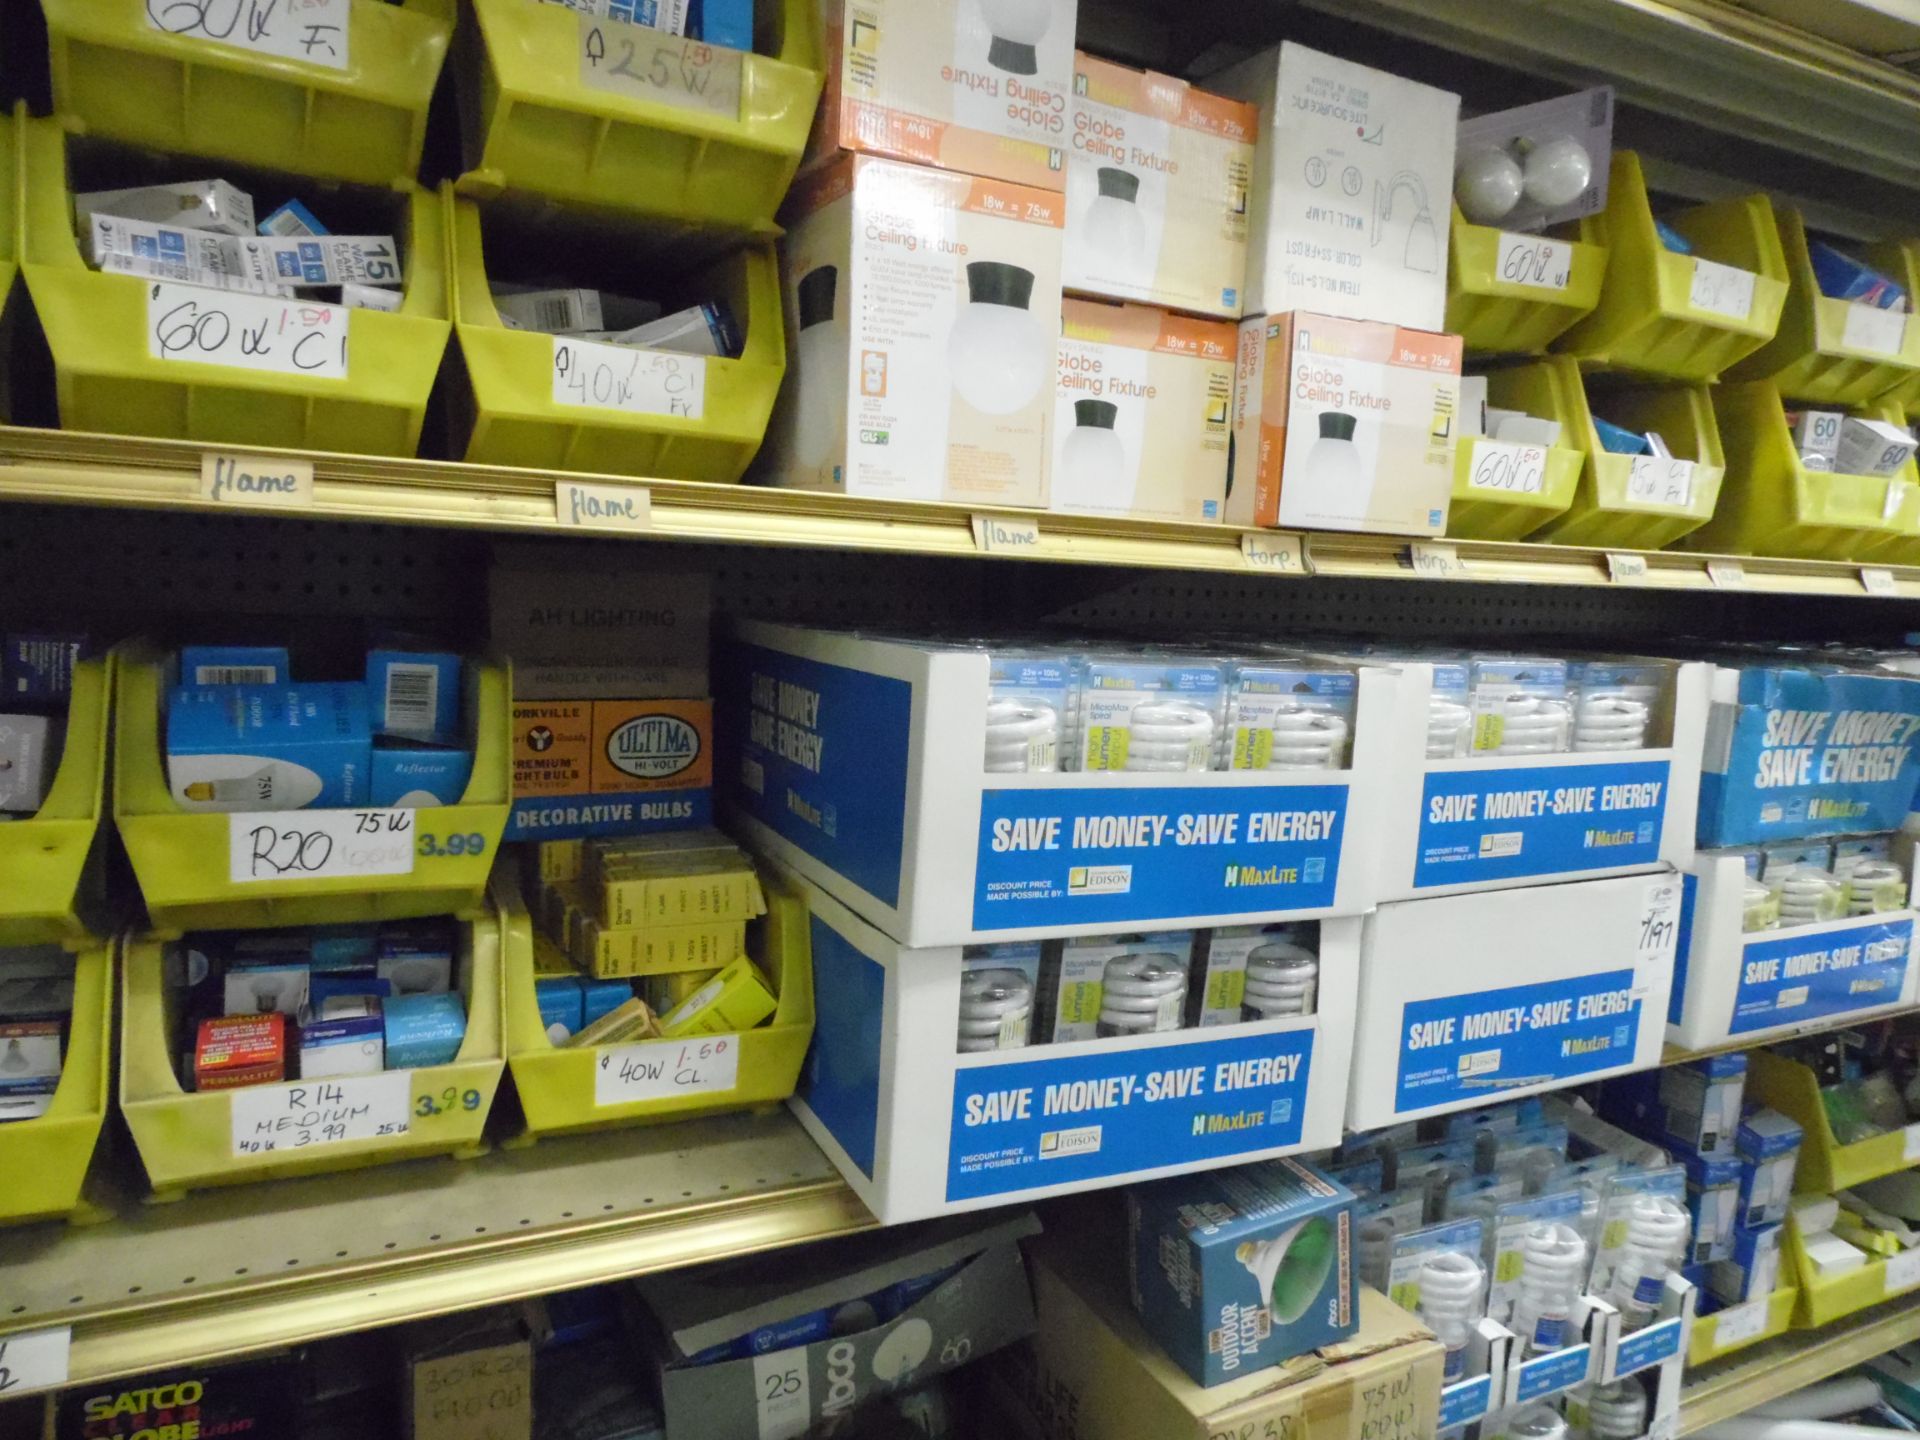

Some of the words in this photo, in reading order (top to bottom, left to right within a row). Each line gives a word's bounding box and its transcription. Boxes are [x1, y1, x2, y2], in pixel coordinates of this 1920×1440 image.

[940, 66, 999, 99] Fixture
[1006, 79, 1065, 112] Ceiling
[1007, 104, 1064, 133] Globe
[1073, 112, 1125, 141] Globe
[1072, 132, 1126, 164] Ceiling
[1132, 148, 1178, 175] Fixture
[983, 194, 1005, 210] 18w
[1027, 202, 1051, 219] 75w
[1306, 206, 1334, 223] LAMP
[1336, 212, 1364, 231] WALL
[865, 224, 917, 251] Ceiling
[339, 243, 355, 281] FLAME
[349, 243, 367, 280] WATT
[364, 243, 394, 279] 15
[1166, 335, 1186, 349] 18w
[1202, 340, 1224, 355] 75w
[1248, 327, 1259, 377] Globe
[1399, 349, 1417, 363] 18w
[1431, 352, 1452, 367] 75w
[1057, 370, 1103, 396] eiling
[1109, 377, 1157, 400] Fixture
[1296, 363, 1344, 386] Globe
[1295, 383, 1344, 408] Ceiling
[1348, 389, 1392, 412] Fixture
[1814, 416, 1837, 438] 60
[1879, 444, 1909, 465] 60
[211, 457, 299, 501] flame
[571, 487, 639, 524] flame
[983, 519, 1038, 551] flame
[529, 608, 562, 627] AH
[570, 607, 675, 628] LIGHTING
[513, 708, 581, 719] ORKVILLE
[1089, 711, 1112, 720] Spiral
[1090, 703, 1129, 712] MicroMax
[618, 719, 692, 754] ULTIMA
[1762, 709, 1832, 748] SAVE
[1828, 711, 1920, 747] MONEY
[778, 720, 823, 774] ENERGY
[1100, 725, 1111, 771] Lumen
[395, 763, 448, 776] Reflector
[634, 759, 680, 770] HI-VOLT
[1755, 749, 1814, 789] SAVE
[1819, 746, 1910, 785] ENERGY
[260, 775, 272, 801] 75W
[344, 763, 355, 803] Reflector
[516, 804, 633, 828] DECORATIVE
[640, 801, 693, 821] BULBS
[1429, 794, 1477, 824] SAVE
[1601, 782, 1662, 811] ENERGY
[418, 833, 485, 857] 3.99
[991, 817, 1062, 852] SAVE
[1247, 811, 1337, 843] ENERGY
[248, 825, 334, 877] R20
[987, 881, 1028, 892] DISCOUNT
[1030, 879, 1052, 889] PRICE
[1089, 872, 1129, 887] EDISON
[986, 891, 1012, 902] MADE
[1014, 890, 1050, 901] POSSIBLE
[1052, 889, 1064, 899] BY:
[1745, 957, 1780, 985] SAVE
[1408, 1018, 1455, 1051] SAVE
[201, 1068, 278, 1086] PERMALITE
[619, 1056, 664, 1084] 40W
[415, 1087, 481, 1117] 3.99
[964, 1087, 1033, 1127] SAVE
[1214, 1054, 1302, 1093] ENERGY
[255, 1106, 370, 1135] MEDIUM
[294, 1124, 346, 1148] 3.99
[1060, 1132, 1099, 1149] EDISON
[960, 1162, 986, 1173] MADE
[988, 1157, 1023, 1169] POSSIBLE
[1025, 1155, 1035, 1164] BY:
[961, 1151, 1000, 1164] DISCOUNT
[1002, 1147, 1024, 1158] PRICE
[1221, 1302, 1240, 1370] OUTDOOR
[1240, 1303, 1258, 1354] ACCENT
[765, 1369, 801, 1401] 25
[83, 1381, 203, 1422] SATCO
[202, 1419, 253, 1437] LIGHT
